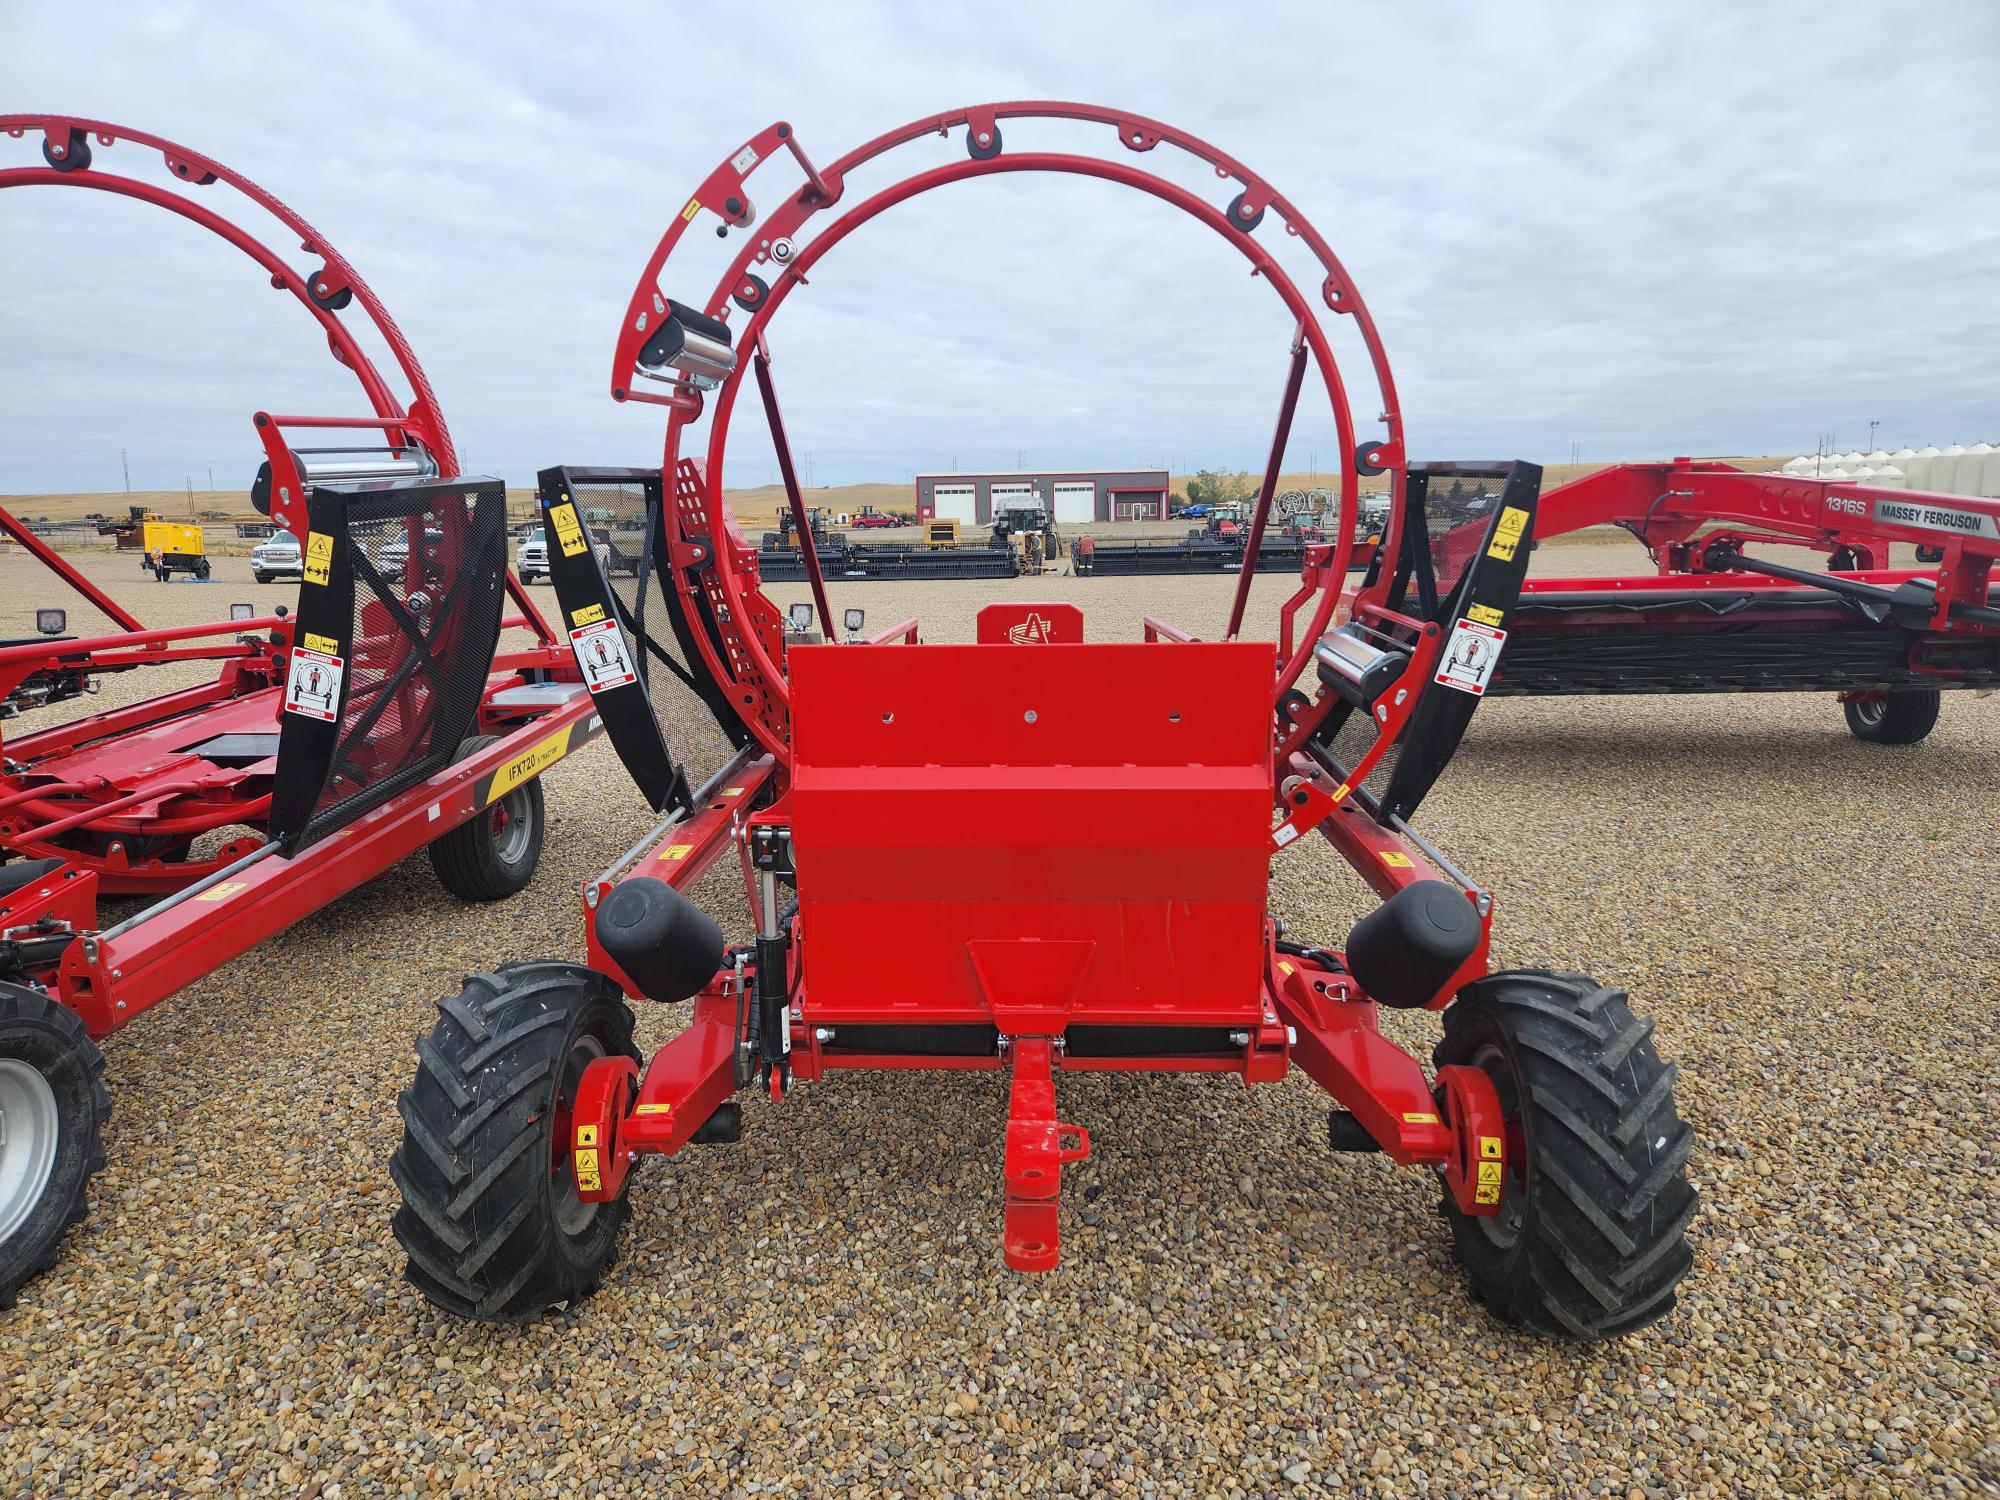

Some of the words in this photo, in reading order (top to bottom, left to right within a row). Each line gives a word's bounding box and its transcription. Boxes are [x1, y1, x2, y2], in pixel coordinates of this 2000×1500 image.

[1826, 497, 1866, 515] 1316S
[1881, 505, 1922, 521] MASSEY
[1923, 510, 1982, 530] FERGUSON
[585, 623, 608, 635] DANGER
[309, 653, 333, 665] DANGER
[604, 676, 627, 688] DANGER
[302, 707, 325, 718] DANGER
[508, 754, 535, 781] IFX720
